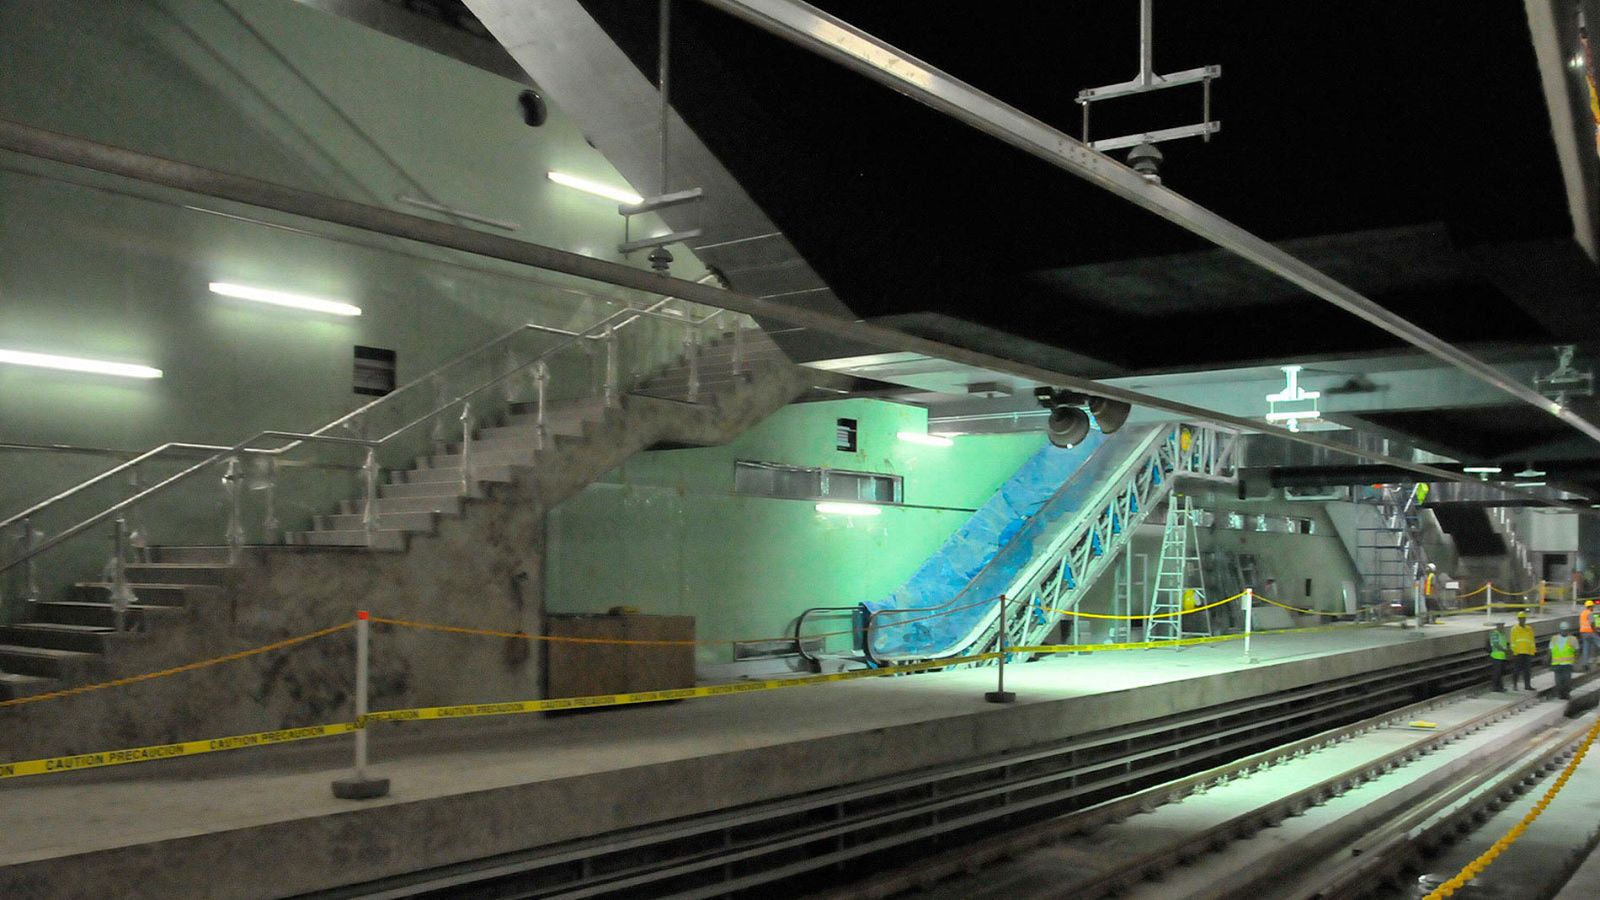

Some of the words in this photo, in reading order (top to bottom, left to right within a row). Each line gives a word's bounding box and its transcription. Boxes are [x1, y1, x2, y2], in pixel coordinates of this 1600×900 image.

[437, 707, 475, 718] CAUTION
[477, 703, 524, 714] PRECAUCION
[211, 736, 258, 749] CAUTION
[262, 727, 325, 741] PRECAUCION
[46, 755, 104, 770] CAUTION
[109, 745, 185, 762] PRECAUCION
